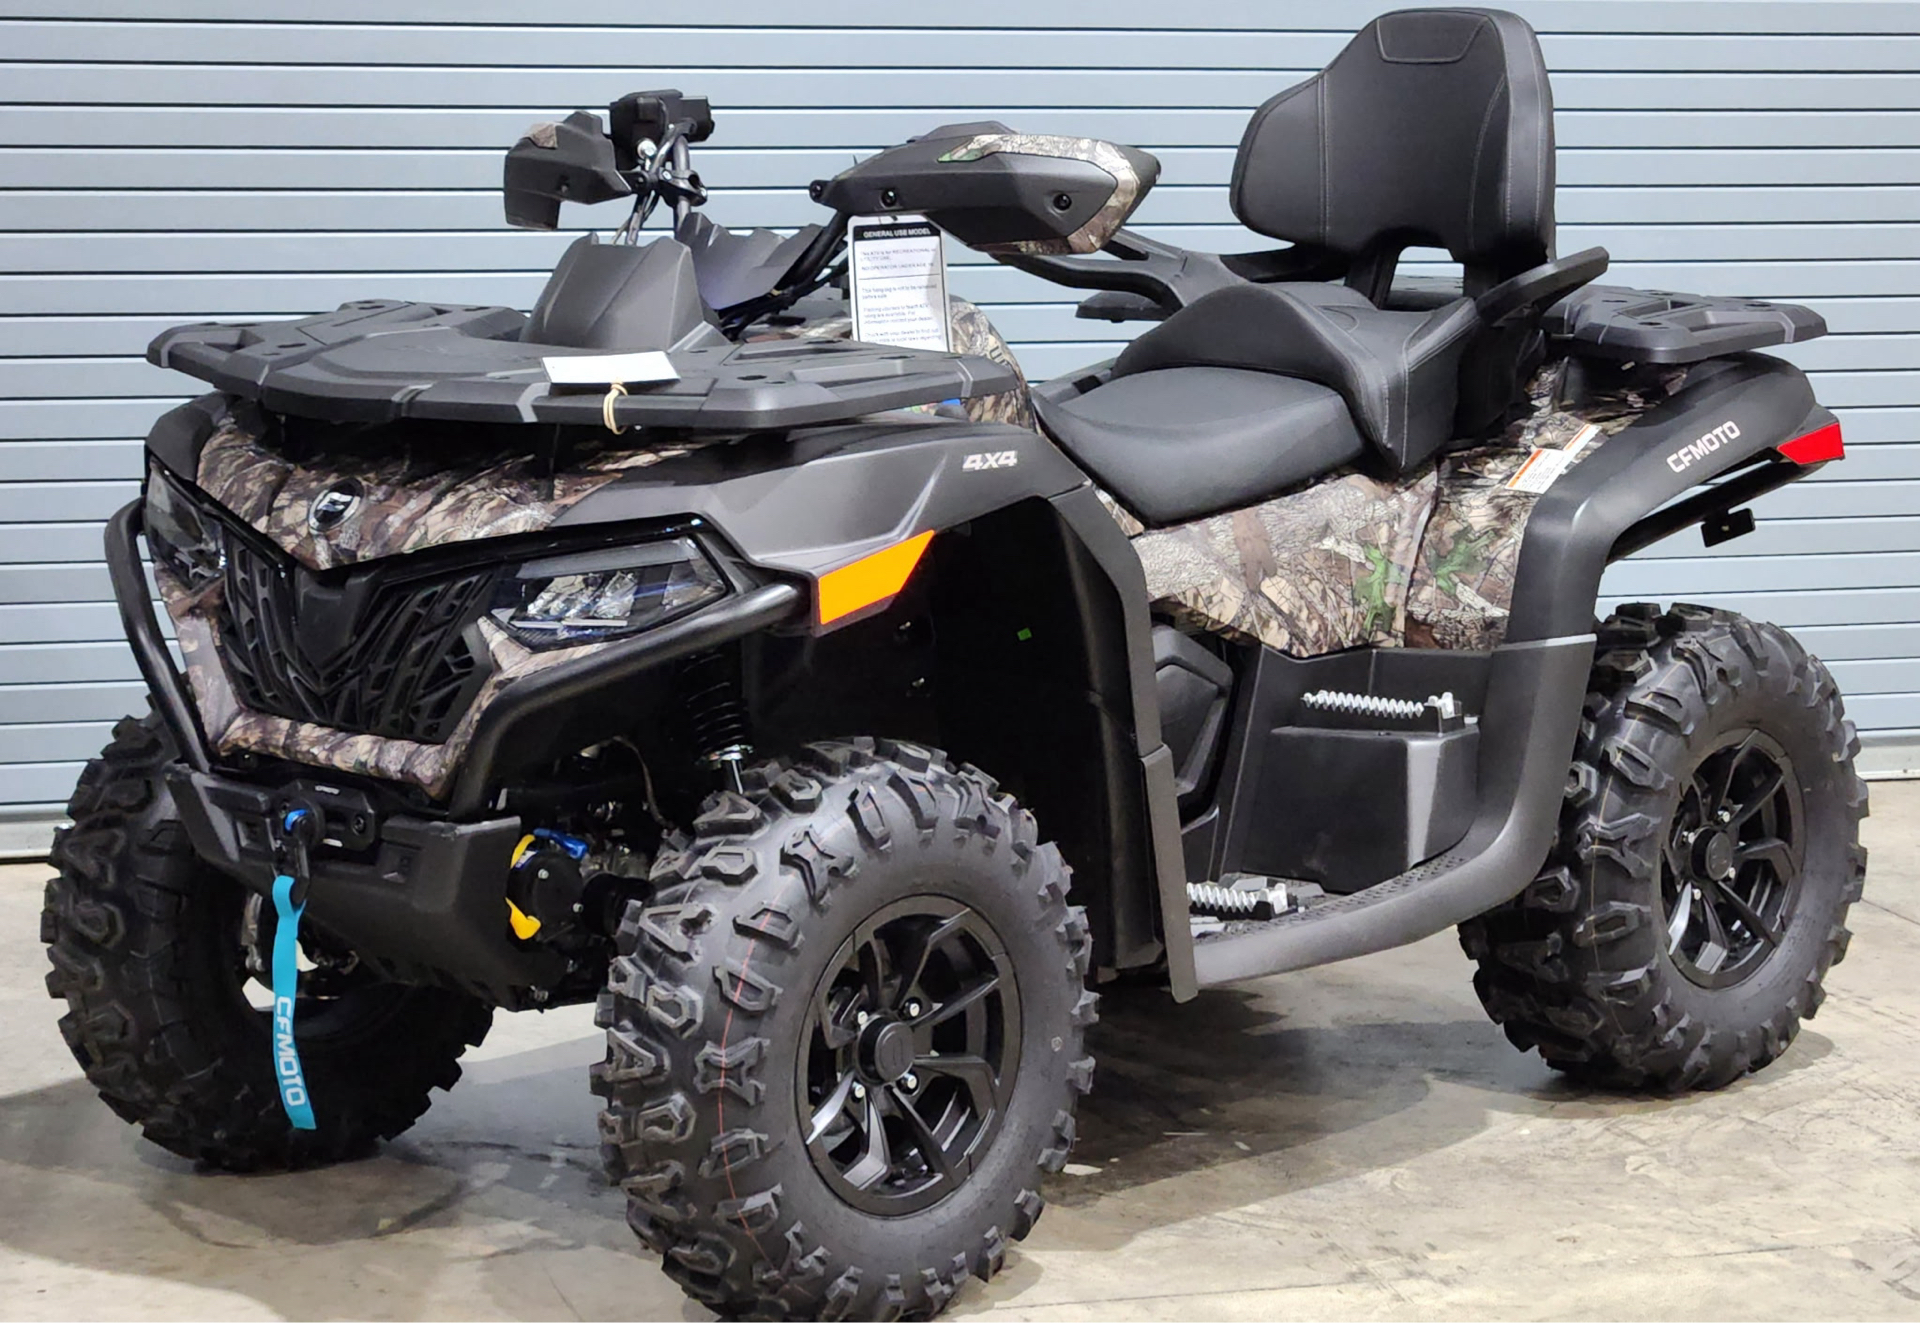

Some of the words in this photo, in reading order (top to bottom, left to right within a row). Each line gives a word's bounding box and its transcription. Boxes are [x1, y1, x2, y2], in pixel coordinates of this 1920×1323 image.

[863, 230, 893, 238] GENERAL
[908, 227, 930, 236] MODEL
[1666, 420, 1741, 473] CFMOTO
[276, 995, 306, 1107] CFMOTO
